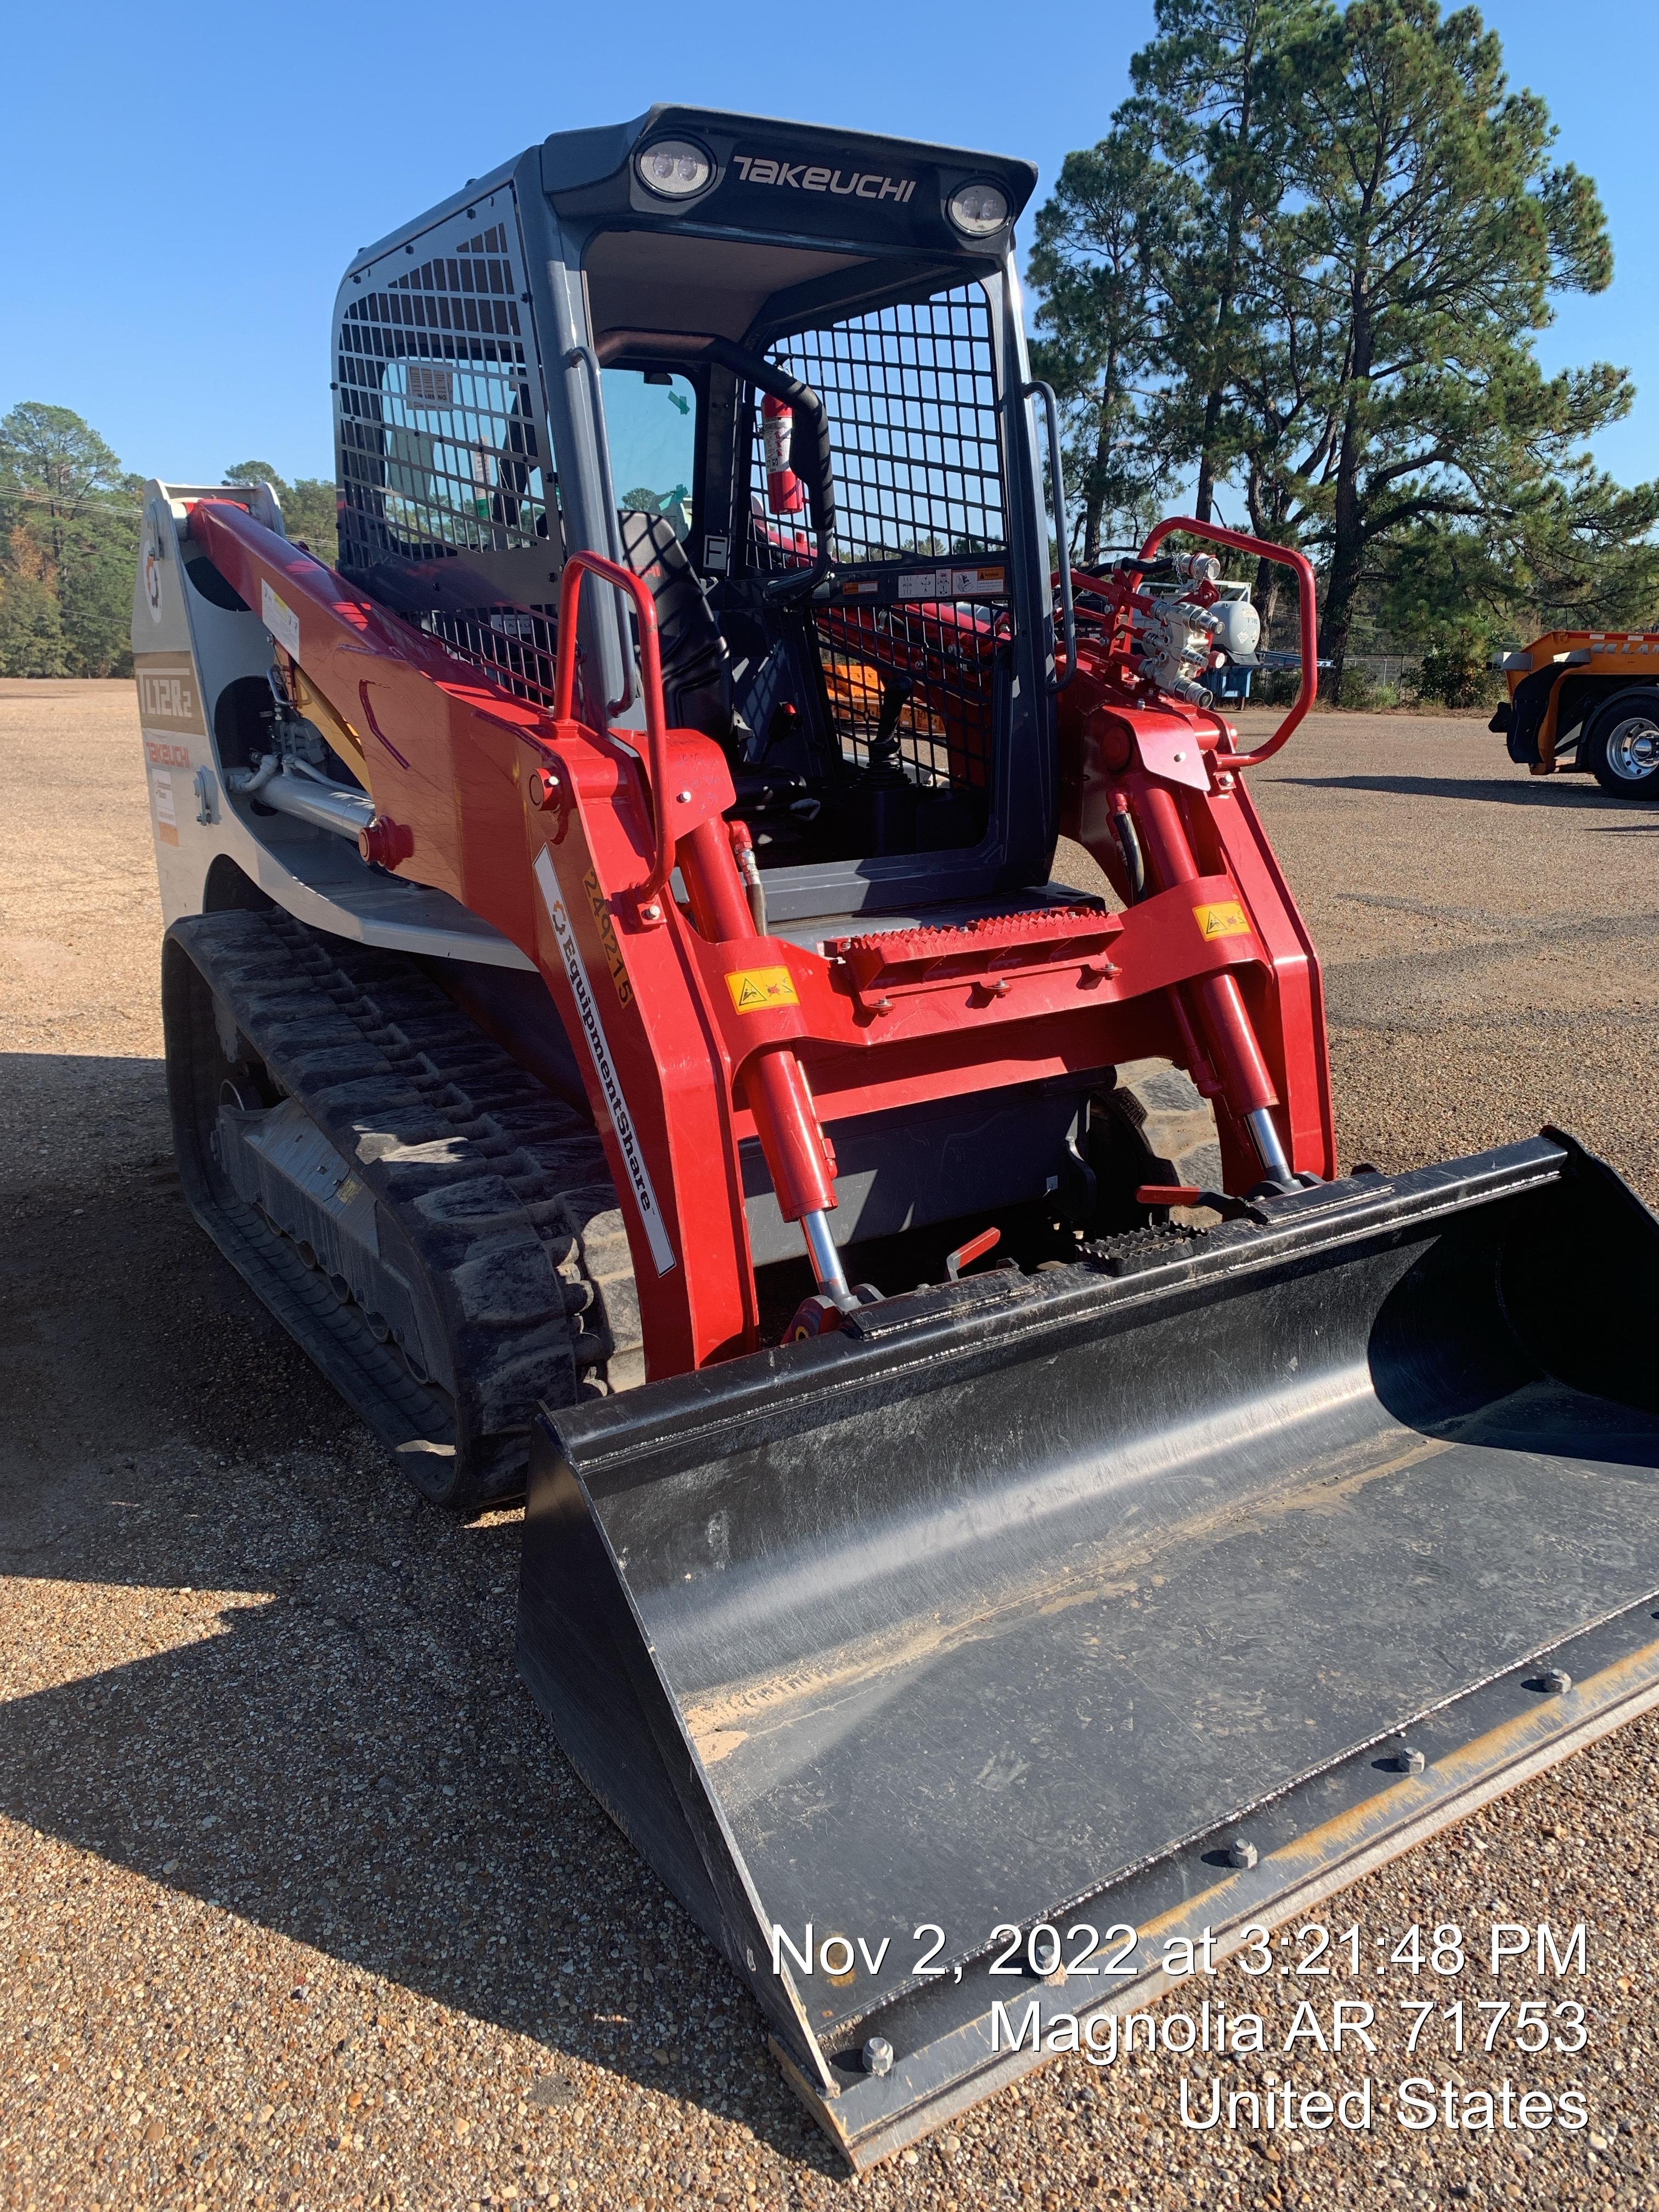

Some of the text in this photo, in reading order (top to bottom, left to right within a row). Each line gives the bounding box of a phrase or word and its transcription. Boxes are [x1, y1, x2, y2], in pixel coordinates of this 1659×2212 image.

[733, 155, 916, 203] TAKEUCHI
[706, 538, 725, 565] F
[146, 742, 190, 769] TAKEUCHI
[584, 871, 634, 1003] 249215
[562, 935, 651, 1212] EquipmentShare
